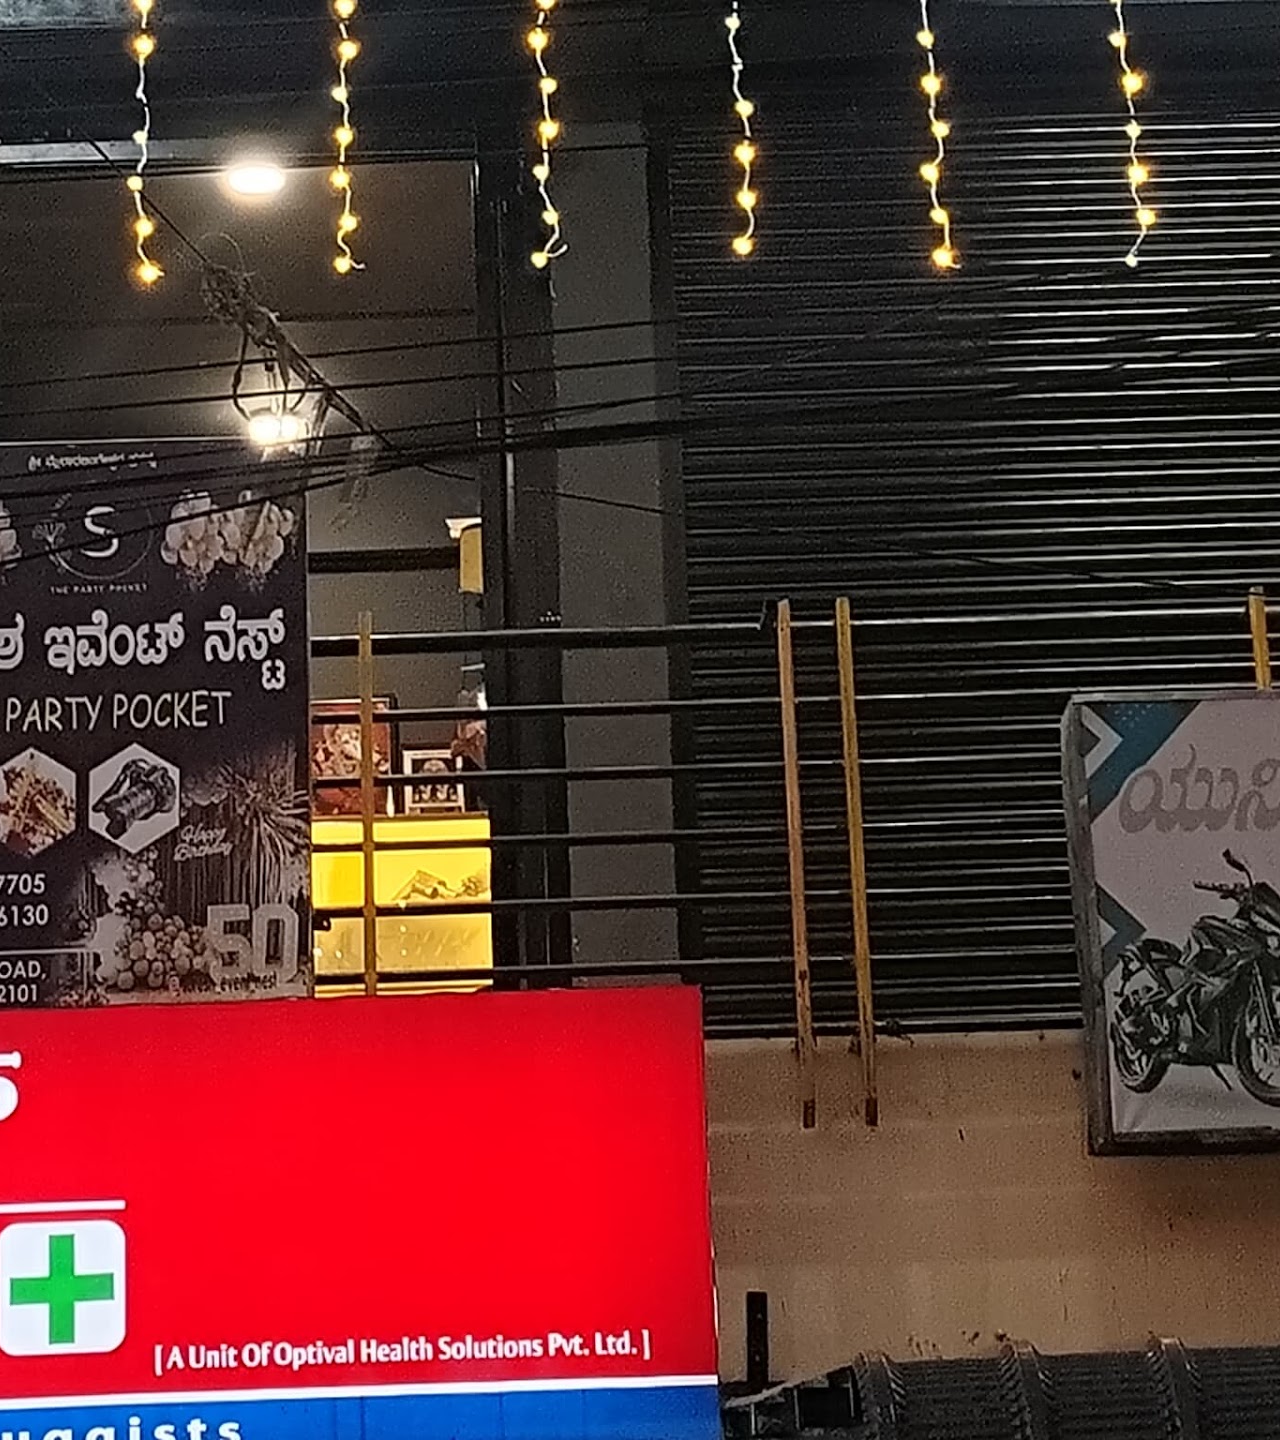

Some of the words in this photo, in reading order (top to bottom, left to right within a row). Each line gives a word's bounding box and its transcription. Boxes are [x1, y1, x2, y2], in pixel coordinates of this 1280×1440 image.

[44, 609, 185, 675] ಇವೆಂಟ್
[204, 604, 286, 690] ನೆಸ್ಟ್
[5, 695, 102, 733] PARTY
[113, 691, 232, 729] POCKET
[189, 1344, 238, 1370] Unit
[241, 1342, 274, 1368] Of
[274, 1339, 356, 1372] Optival
[360, 1336, 433, 1364] Health
[437, 1333, 544, 1360] Solutions
[548, 1333, 590, 1357] Pvt.
